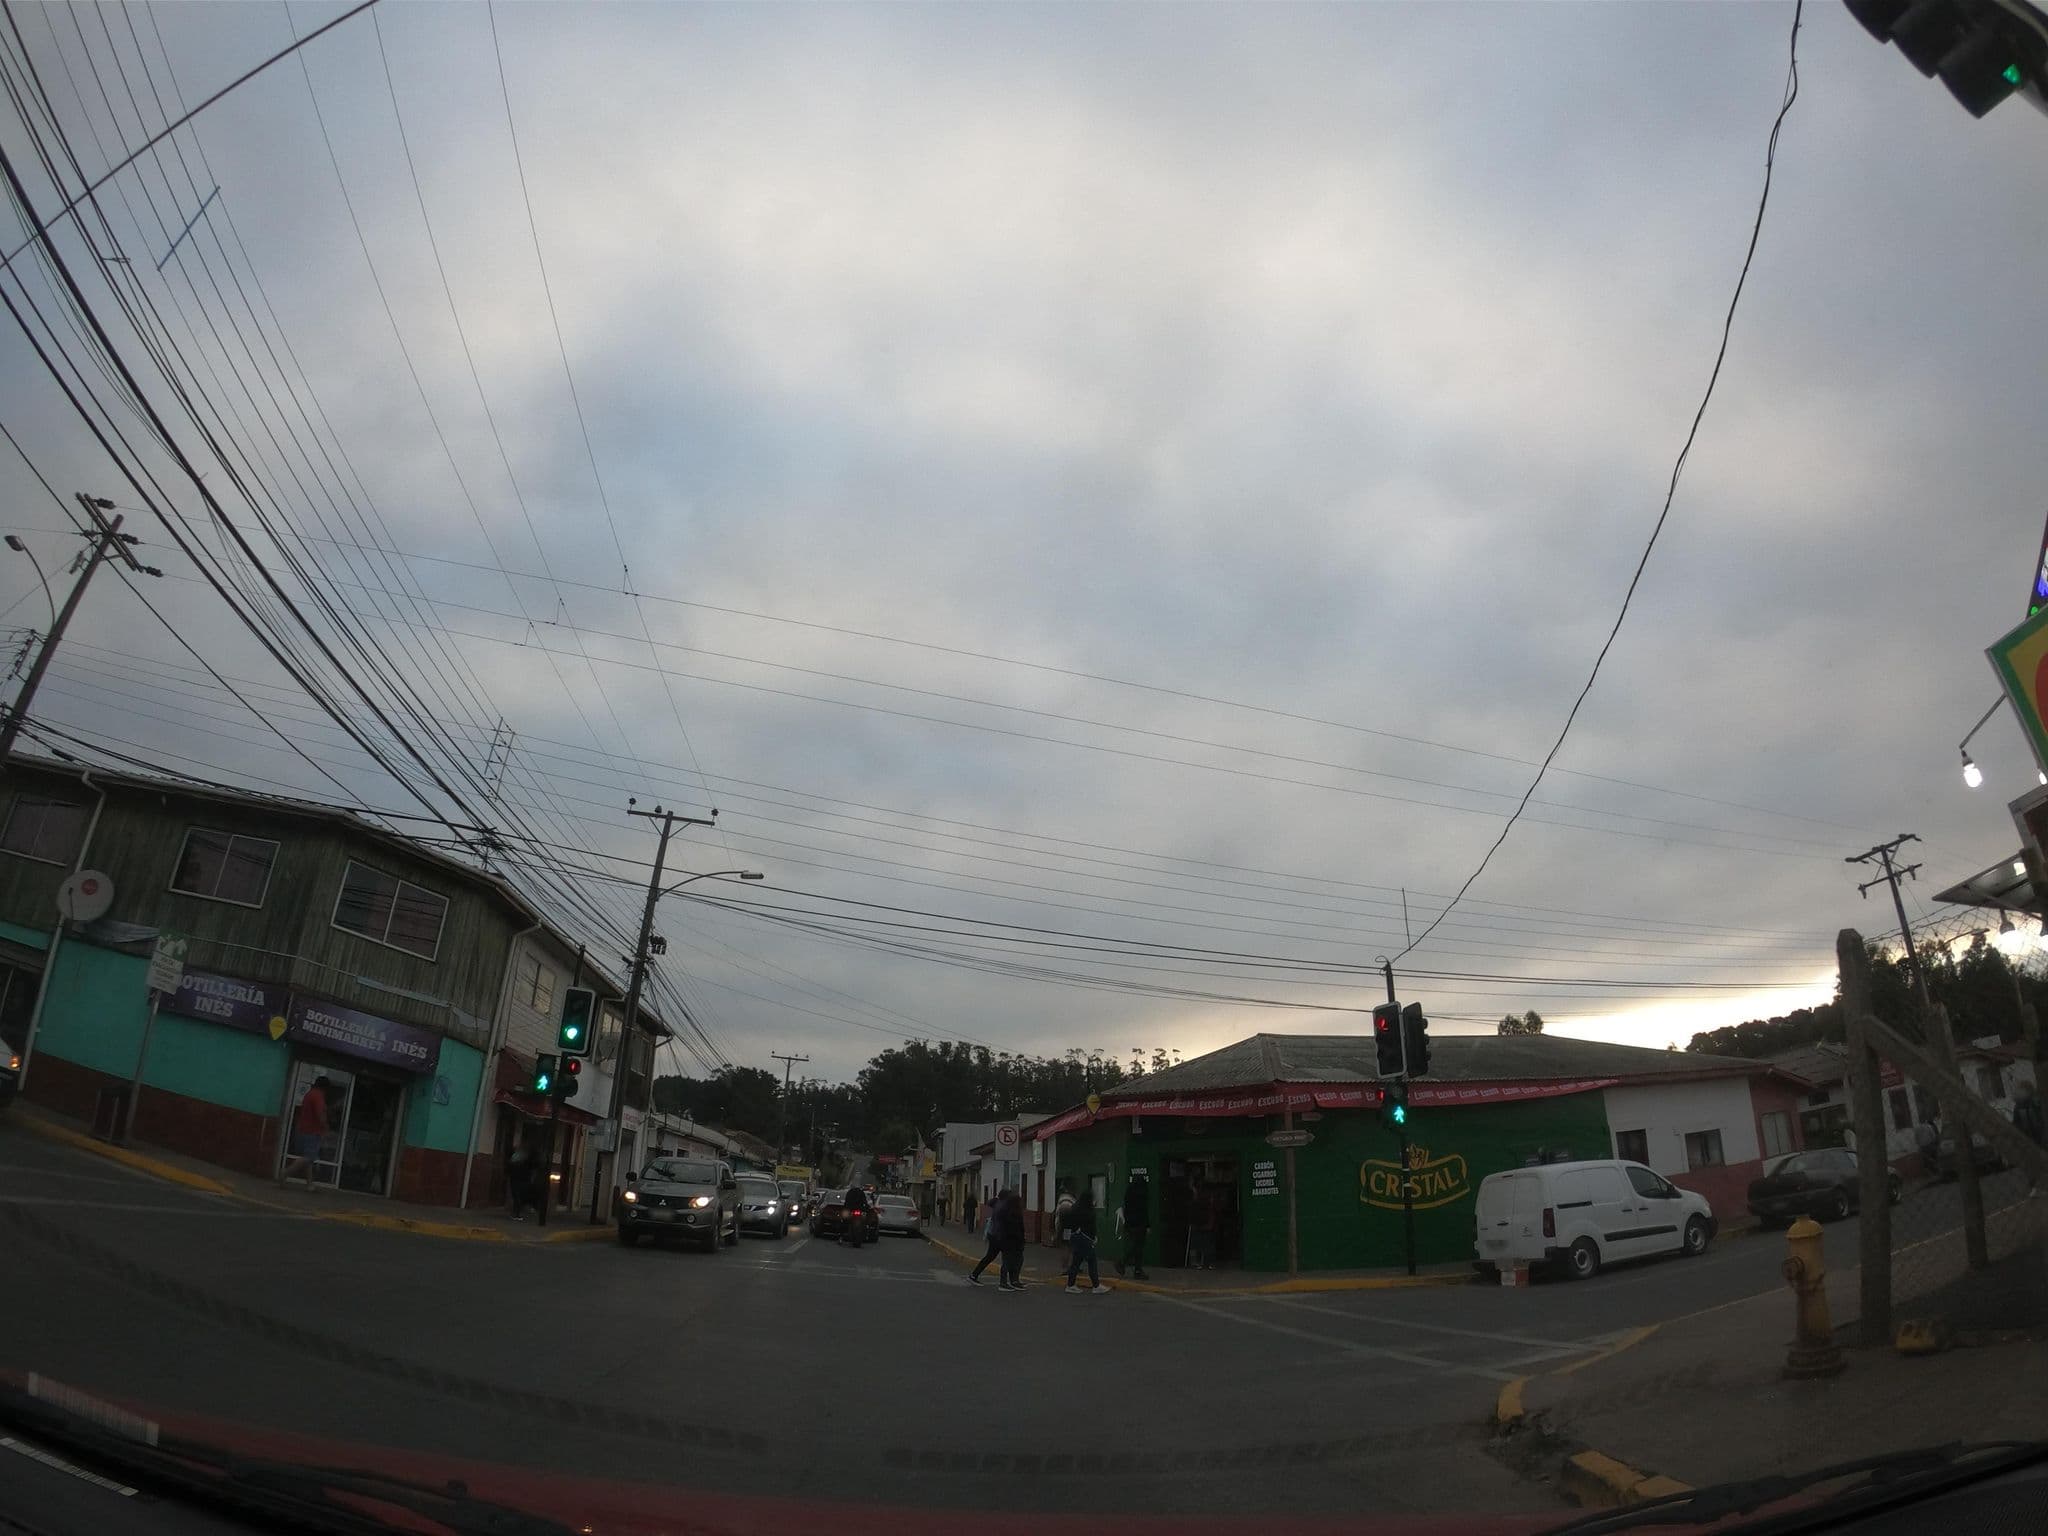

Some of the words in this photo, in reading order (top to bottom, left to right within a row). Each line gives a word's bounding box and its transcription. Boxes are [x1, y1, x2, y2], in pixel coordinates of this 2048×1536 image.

[194, 996, 234, 1017] INÉS
[302, 1020, 385, 1052] MINIMARKET
[306, 1009, 377, 1039] BOTILLERÍA
[392, 1040, 428, 1059] INÉS
